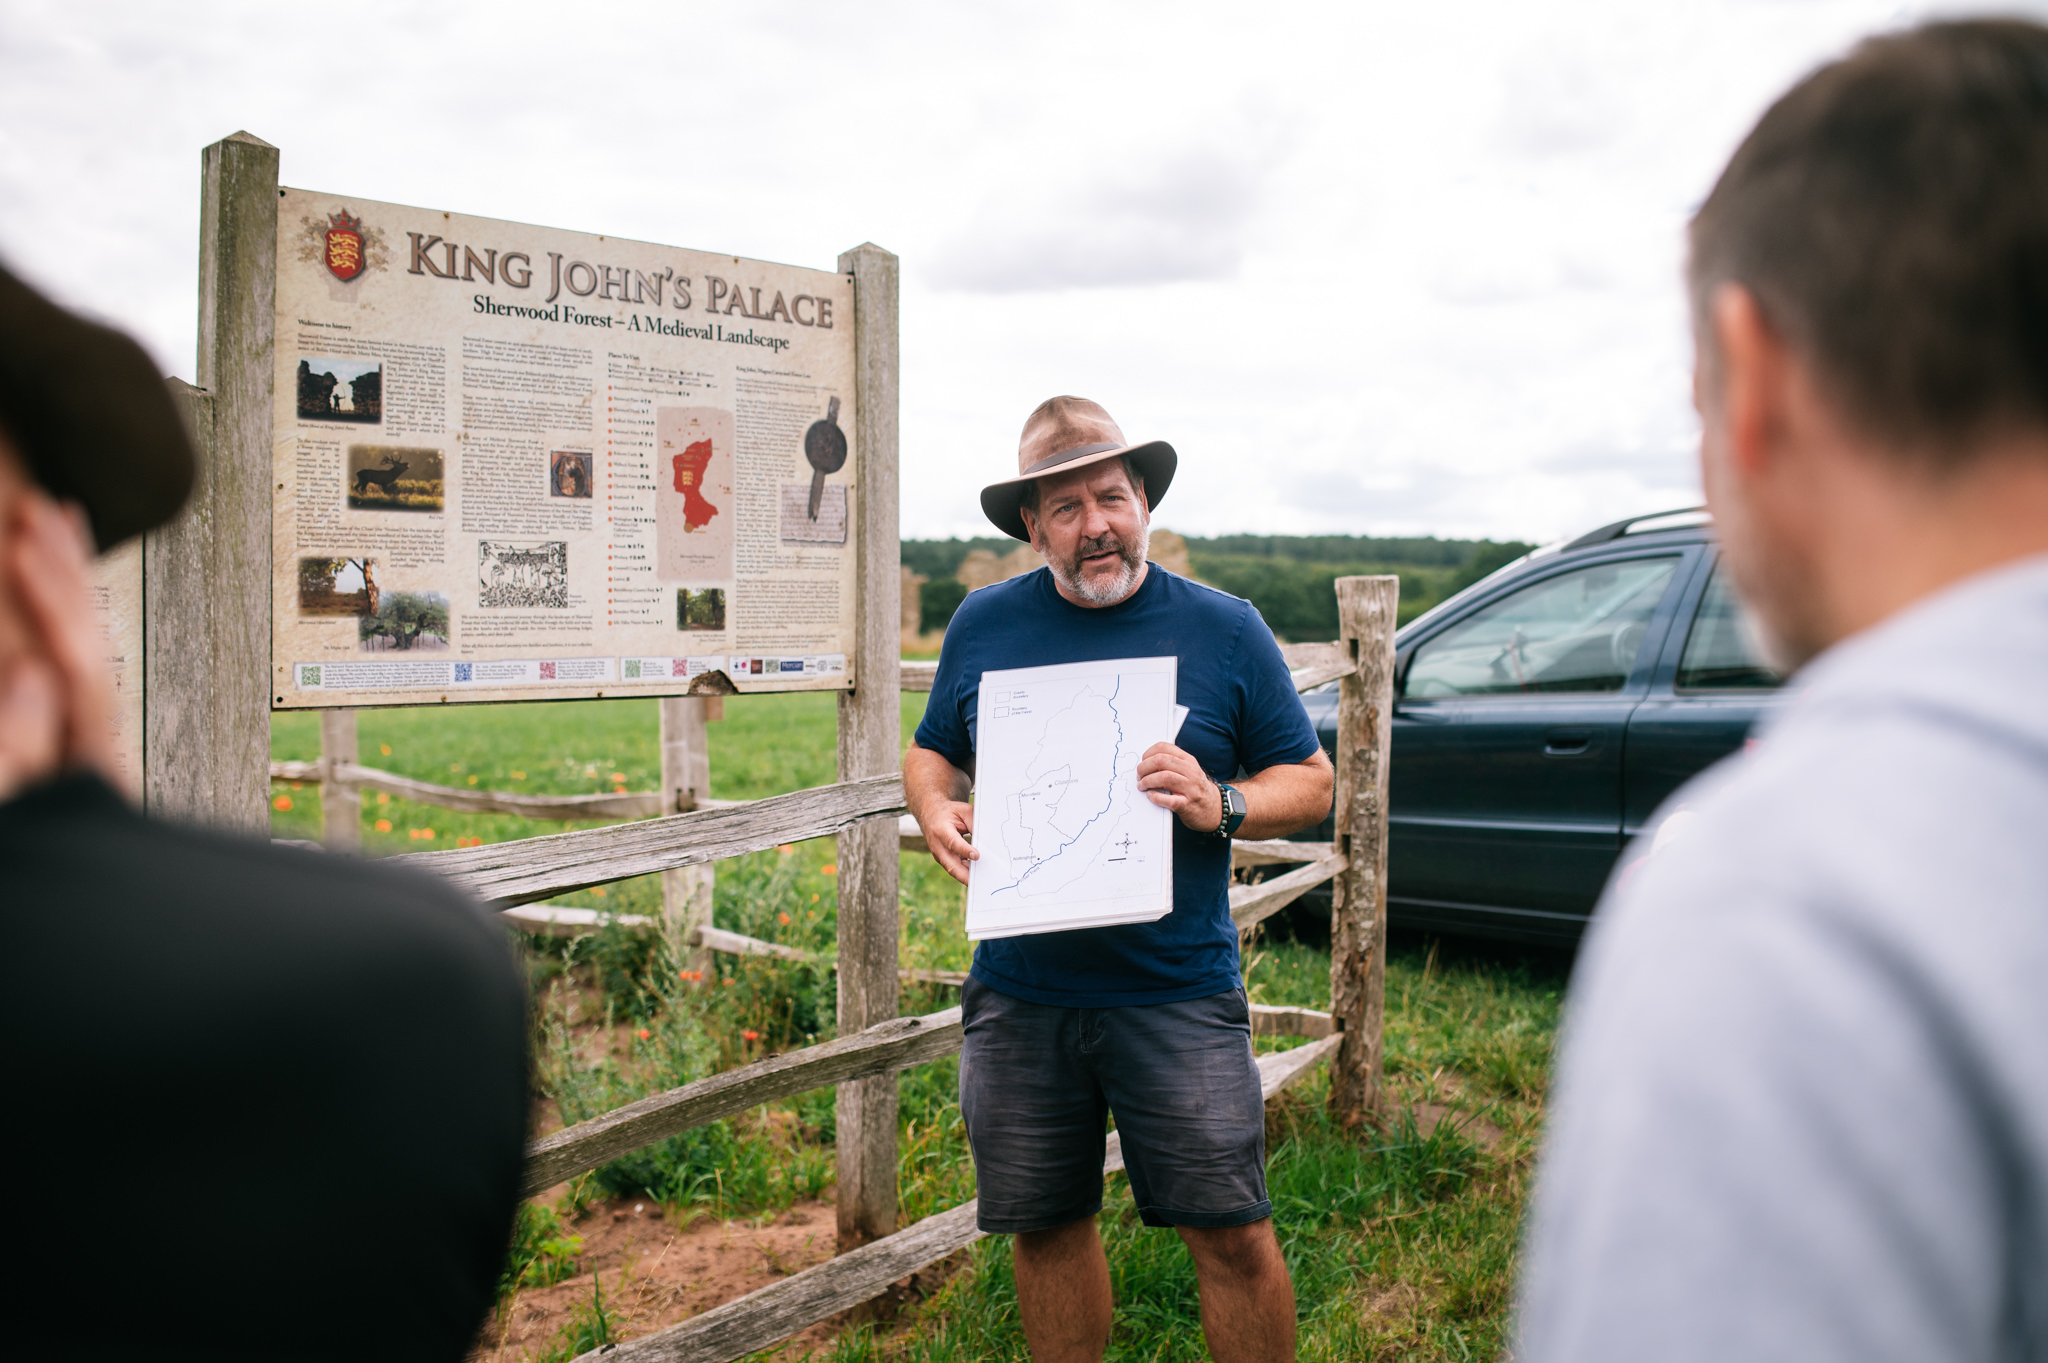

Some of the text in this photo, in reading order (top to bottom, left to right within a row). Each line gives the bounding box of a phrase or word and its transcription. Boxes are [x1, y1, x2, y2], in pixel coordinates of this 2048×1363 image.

[406, 232, 833, 328] KING JOHN'S PALACE
[298, 319, 324, 327] Welcome
[332, 322, 351, 330] history
[473, 295, 558, 322] Sherwood
[564, 306, 612, 328] Forest
[627, 314, 640, 331] A
[644, 315, 713, 342] Medieval
[717, 322, 790, 352] Landscape
